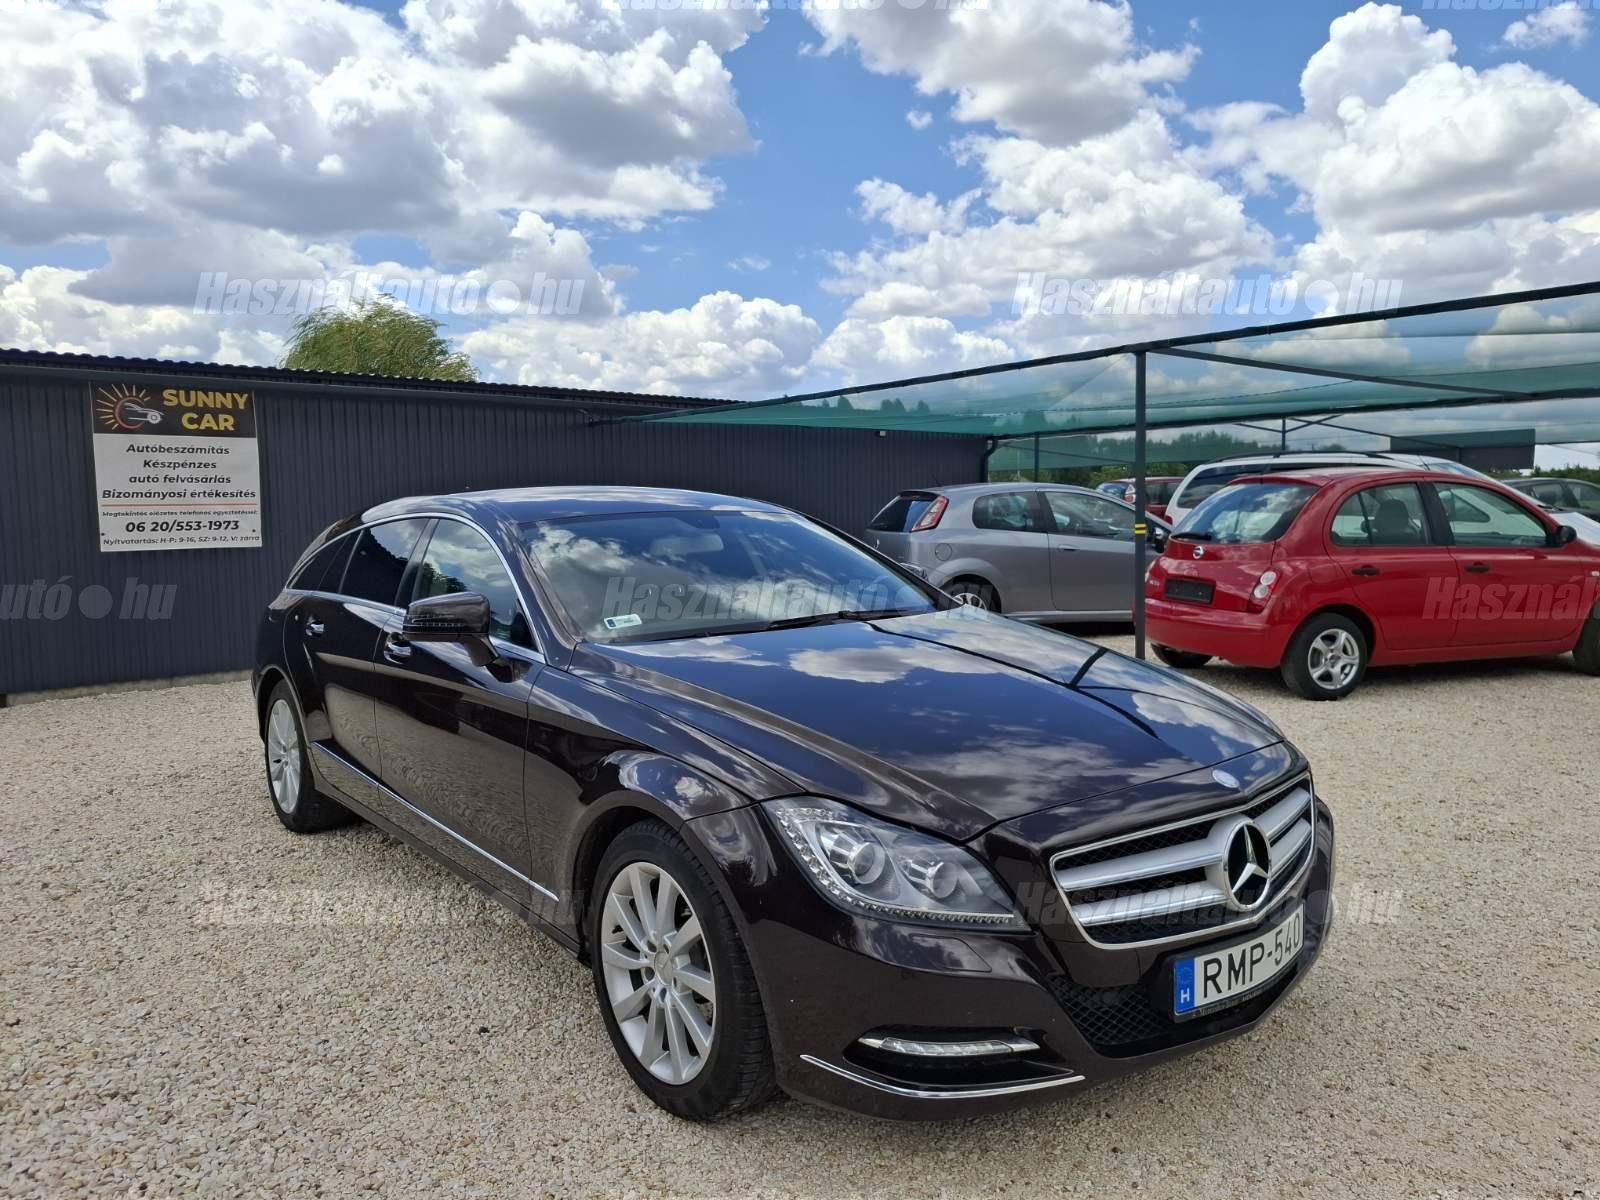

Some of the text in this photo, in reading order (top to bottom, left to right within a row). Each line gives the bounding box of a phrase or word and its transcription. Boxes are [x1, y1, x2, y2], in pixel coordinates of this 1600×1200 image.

[162, 388, 248, 410] SUNNY
[181, 412, 235, 431] CAR
[126, 443, 230, 455] Autóbeszámítás
[143, 459, 217, 471] Készpénzes
[128, 474, 232, 484] autó felvásárlás
[102, 488, 257, 501] Bizományosi értékesítés
[125, 519, 240, 533] 06 20/553-1973
[1202, 912, 1302, 999] RMP-540
[1180, 987, 1190, 1005] H
